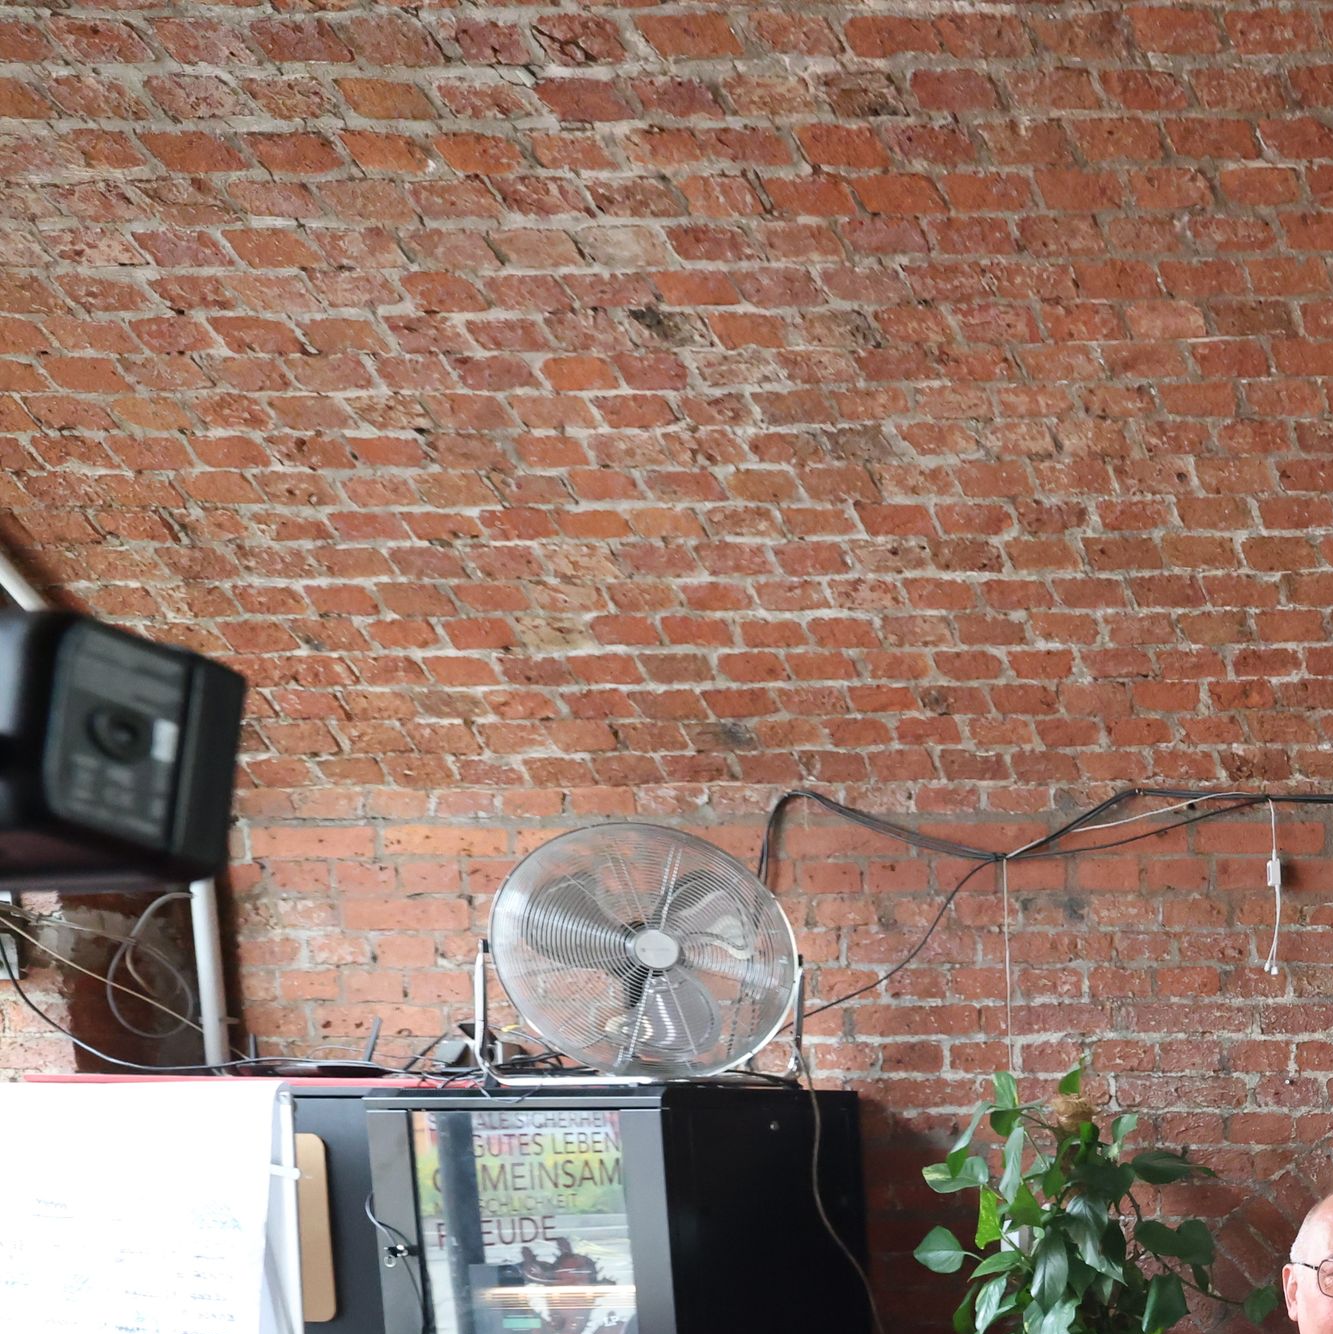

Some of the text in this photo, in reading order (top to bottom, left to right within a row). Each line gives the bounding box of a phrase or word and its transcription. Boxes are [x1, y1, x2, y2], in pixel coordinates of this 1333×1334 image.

[428, 1111, 510, 1132] SALE
[472, 1131, 620, 1158] GUTES LEBEN
[433, 1158, 622, 1193] MEINSAM
[436, 1215, 557, 1250] FEUDE
